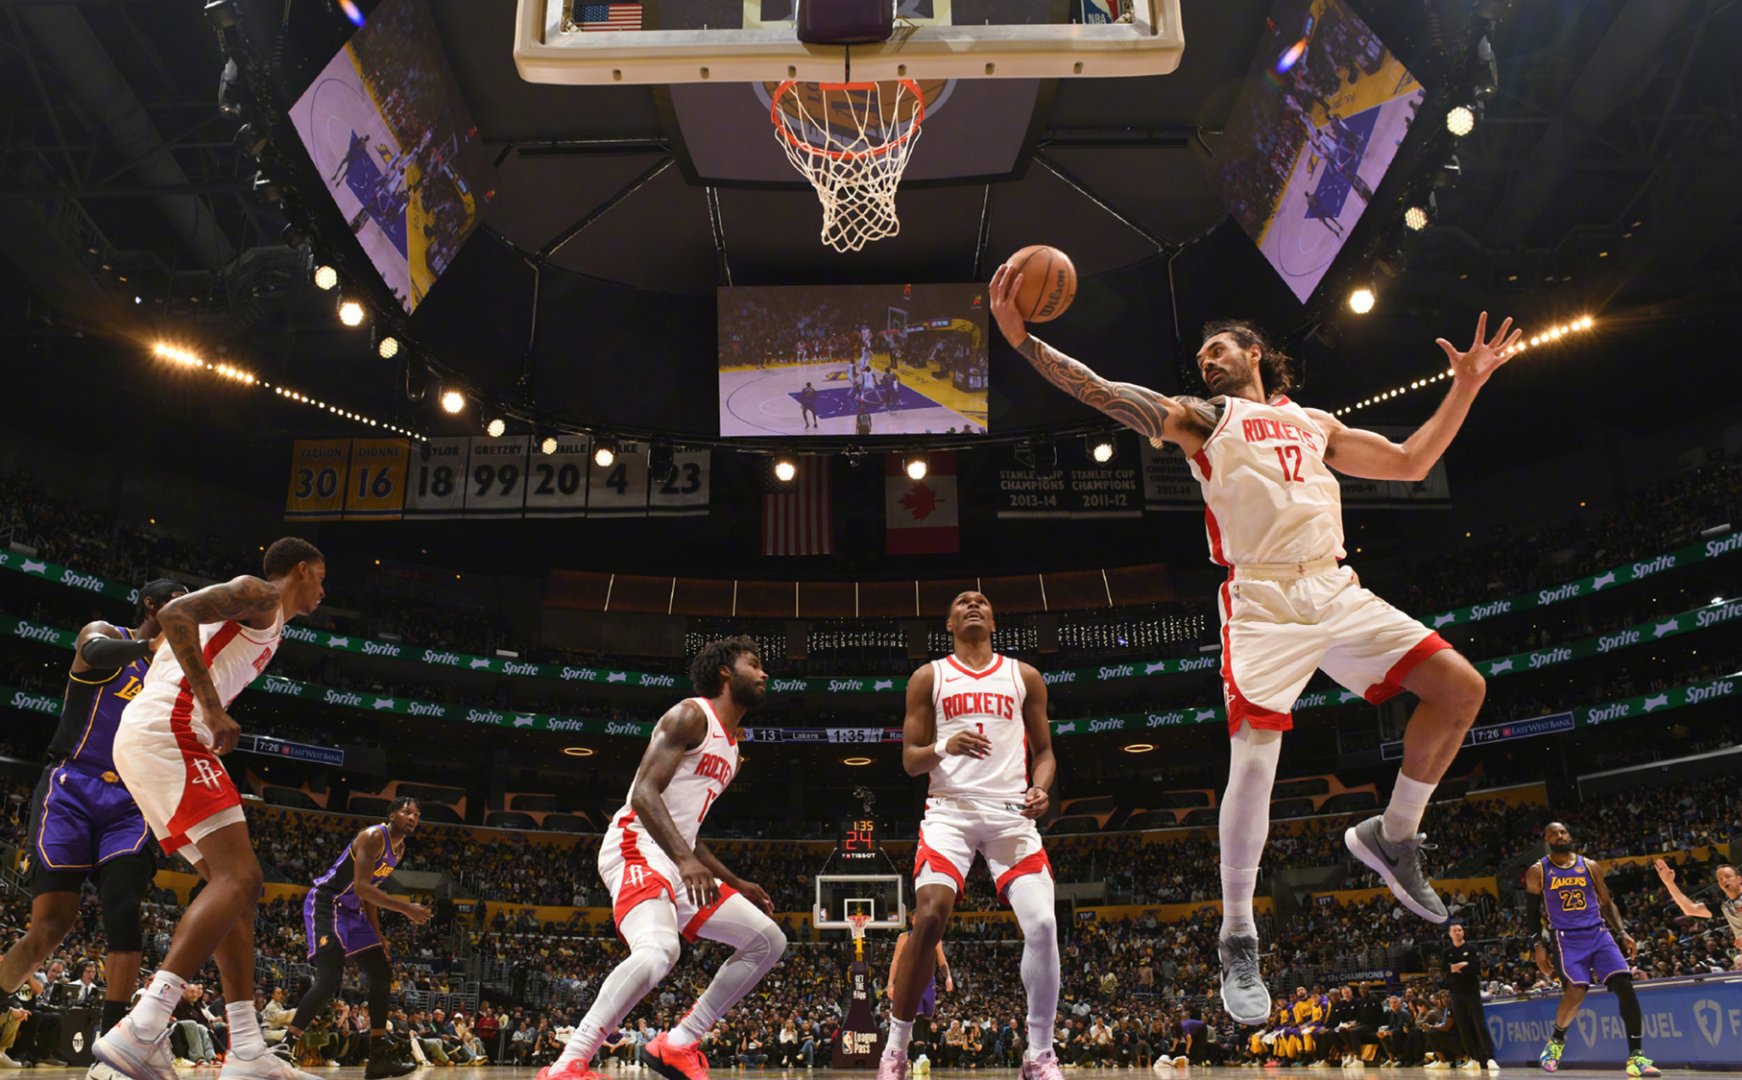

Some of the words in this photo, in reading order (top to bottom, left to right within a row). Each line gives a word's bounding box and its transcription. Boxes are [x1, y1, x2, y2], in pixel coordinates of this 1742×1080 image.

[1087, 13, 1107, 24] NBA
[1039, 269, 1066, 316] Wilson
[1241, 418, 1318, 452] ROCKETS
[358, 447, 401, 457] DIONNE
[474, 443, 523, 456] GRETZKY
[1274, 445, 1305, 483] 12
[358, 467, 393, 498] 16
[418, 466, 453, 497] 18
[474, 463, 519, 497] 99
[534, 463, 580, 495] 20
[606, 463, 628, 495] 4
[659, 462, 701, 495] 23
[1000, 469, 1037, 481] STANLE
[1071, 469, 1113, 480] STANLEY
[1115, 469, 1136, 480] CUP
[295, 467, 338, 499] 30
[1000, 480, 1065, 491] CHAMPIONS
[1072, 480, 1137, 491] CHAMPIONS
[1009, 494, 1057, 507] 2013-14
[1083, 494, 1128, 507] 2011-12
[1631, 555, 1676, 579] Sprite
[60, 569, 104, 593] Sprite
[1538, 583, 1580, 606] Sprite
[1469, 600, 1511, 621] Sprite
[1695, 603, 1742, 631] Sprite
[14, 621, 60, 644] Sprite
[280, 624, 317, 643] Sprite
[1597, 629, 1641, 652] Sprite
[361, 640, 400, 657] Sprite
[422, 649, 460, 666] Sprite
[1178, 656, 1215, 673] Sprite
[1528, 648, 1572, 669] Sprite
[502, 661, 539, 677] Sprite
[560, 666, 597, 681] Sprite
[1097, 665, 1133, 681] Sprite
[639, 673, 675, 688] Sprite
[771, 679, 807, 693] Sprite
[827, 679, 864, 693] Sprite
[1041, 671, 1076, 686] Sprite
[263, 678, 302, 696] Sprite
[1685, 681, 1734, 704] Sprite
[10, 691, 58, 714] Sprite
[324, 689, 362, 706] Sprite
[407, 702, 446, 717] Sprite
[942, 692, 1015, 721] ROCKETS
[1587, 703, 1630, 725] Sprite
[466, 708, 503, 725] Sprite
[546, 717, 583, 732] Sprite
[1146, 712, 1184, 728] Sprite
[605, 722, 641, 736] Sprite
[1088, 718, 1125, 734] Sprite
[760, 730, 776, 741] 13
[792, 732, 819, 740] Lakers
[833, 730, 866, 742] 1:35
[1478, 729, 1500, 740] 7:26
[259, 741, 279, 753] 7:26
[853, 820, 874, 831] 1:35
[845, 831, 872, 850] 24
[1550, 876, 1587, 890] LAKERS
[1559, 889, 1587, 911] 23
[855, 974, 864, 983] GET
[1340, 970, 1385, 981] CHAMPIONS
[855, 982, 864, 990] THE
[854, 1031, 877, 1043] League
[854, 1043, 871, 1054] Pass
